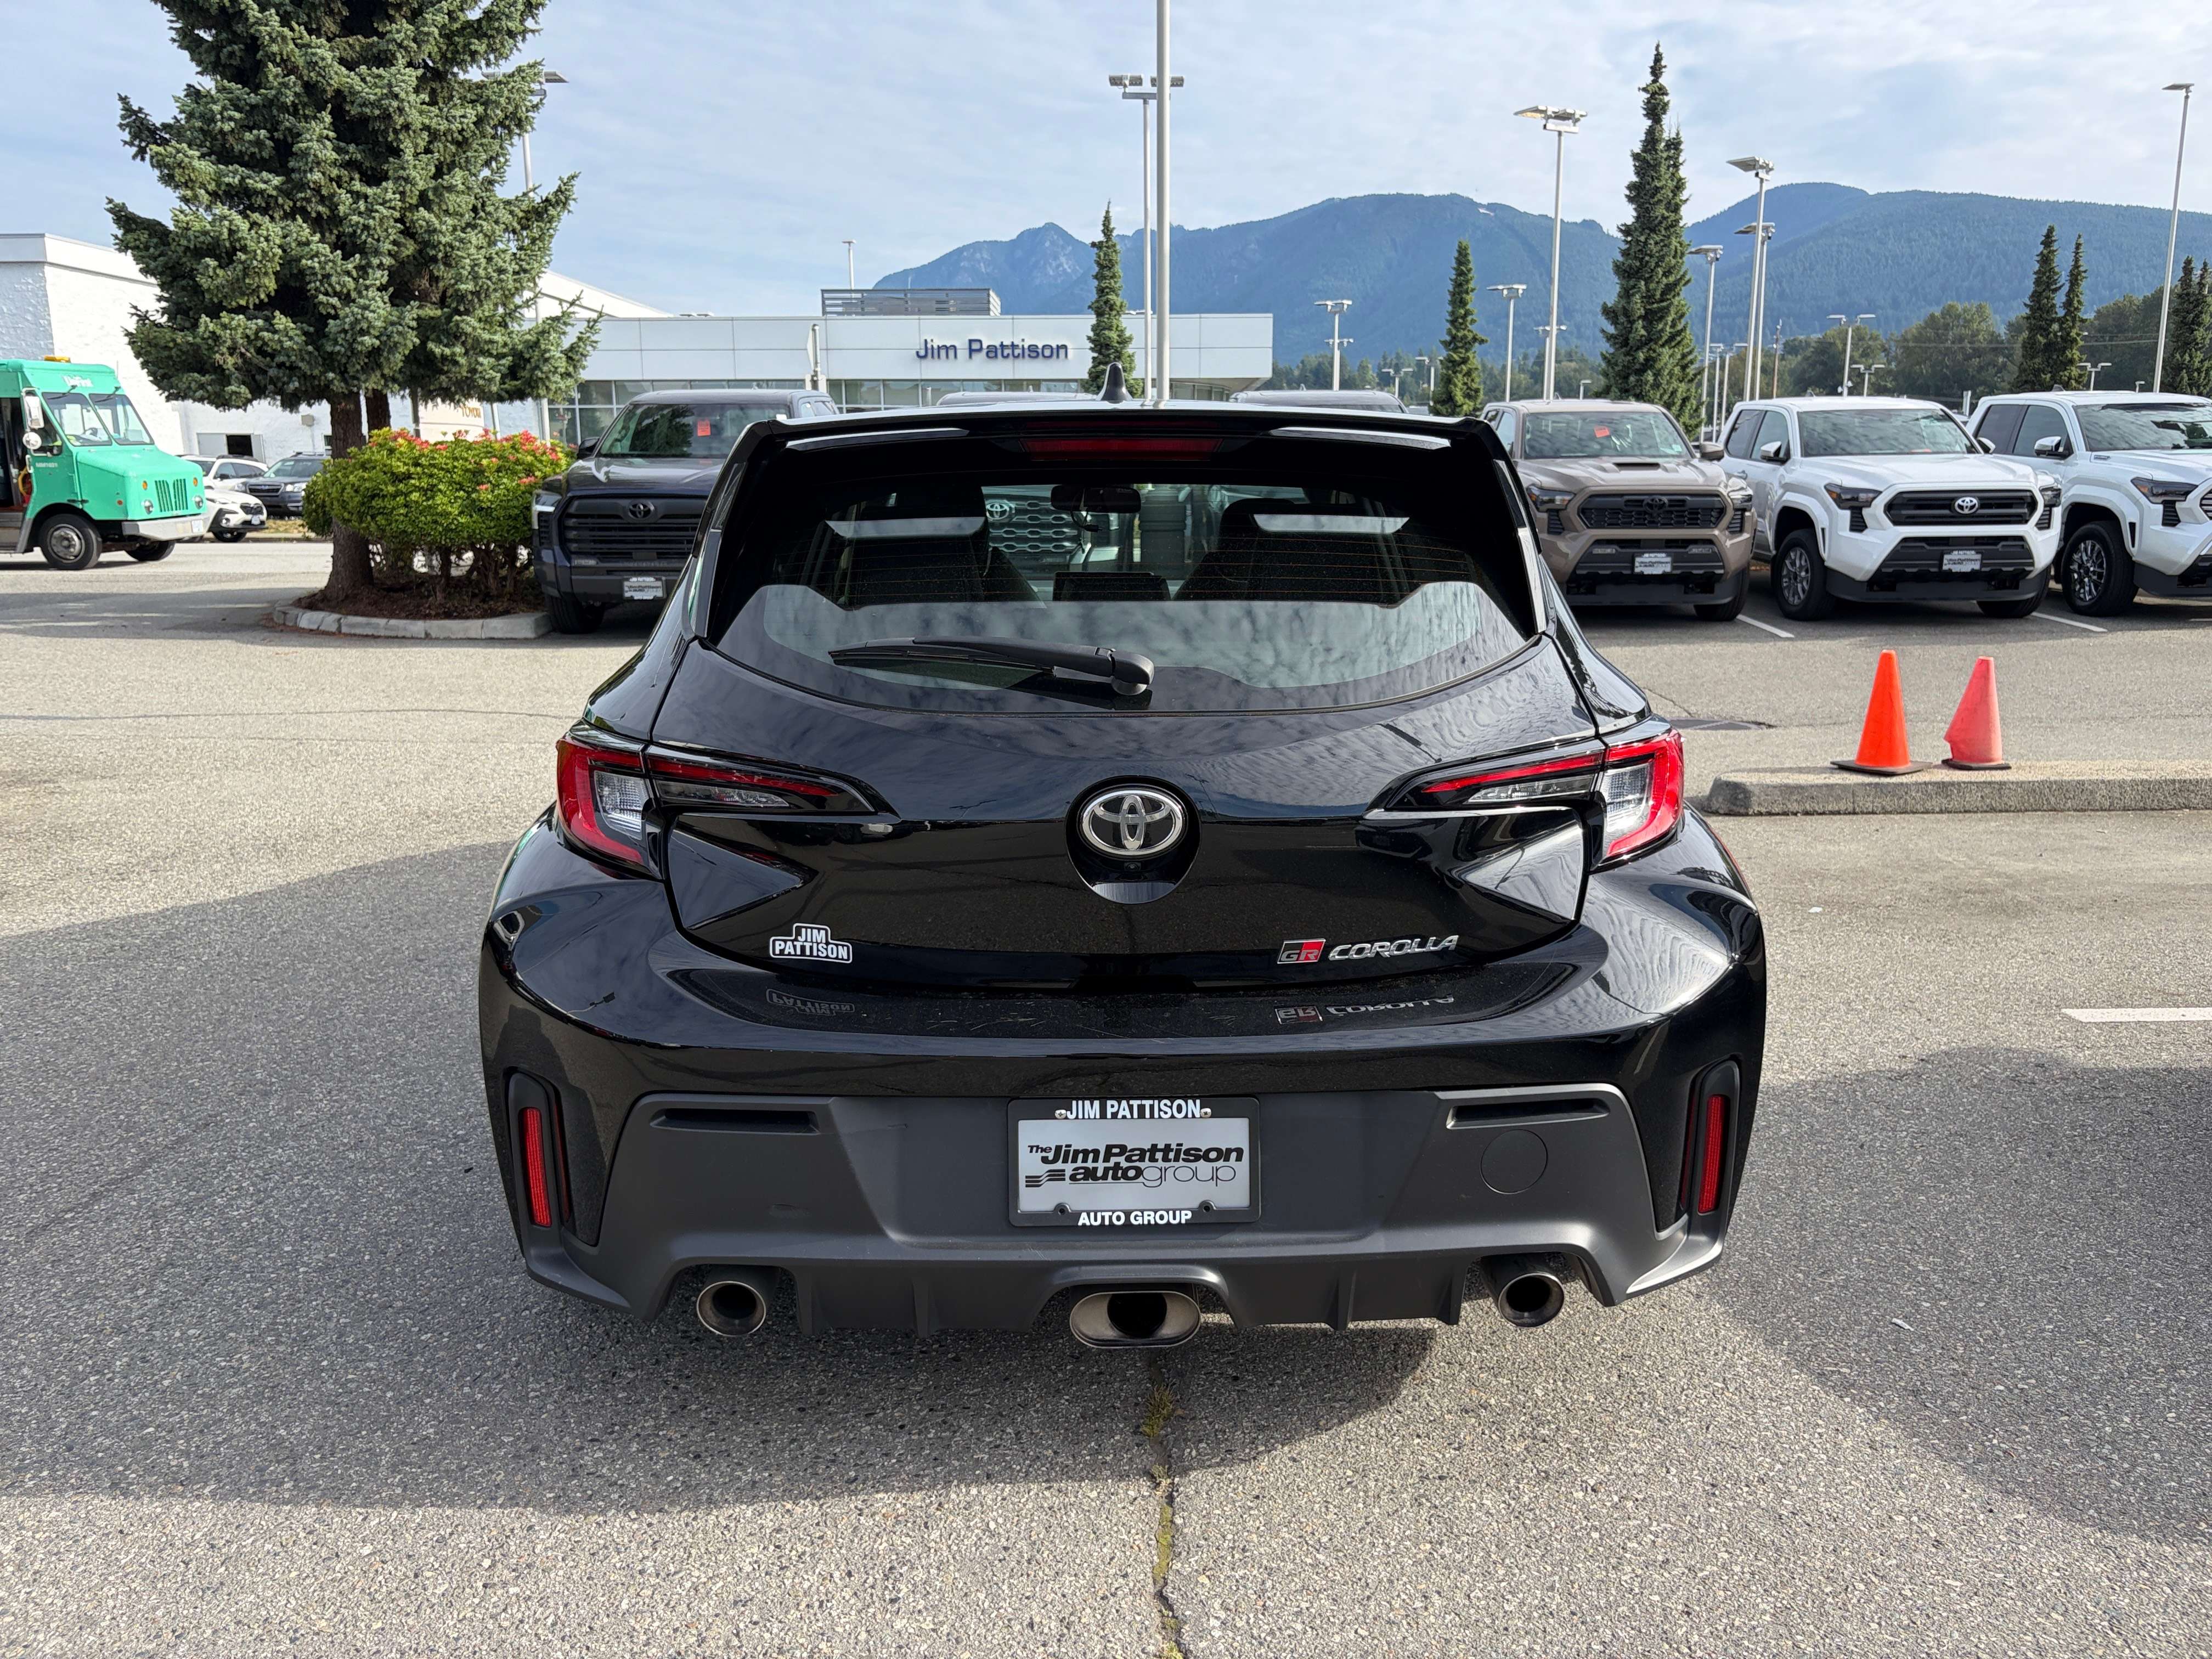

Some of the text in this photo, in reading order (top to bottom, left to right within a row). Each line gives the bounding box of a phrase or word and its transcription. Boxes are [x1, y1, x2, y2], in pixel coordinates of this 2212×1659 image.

[916, 338, 1069, 359] Jim Pattison
[798, 928, 826, 943] JIM
[775, 940, 848, 960] PATTISON
[1281, 935, 1459, 961] GR COROLLA
[1066, 1099, 1201, 1119] JIM PATTISON
[1028, 1145, 1052, 1154] The
[1077, 1210, 1192, 1226] AUTO GROUP
